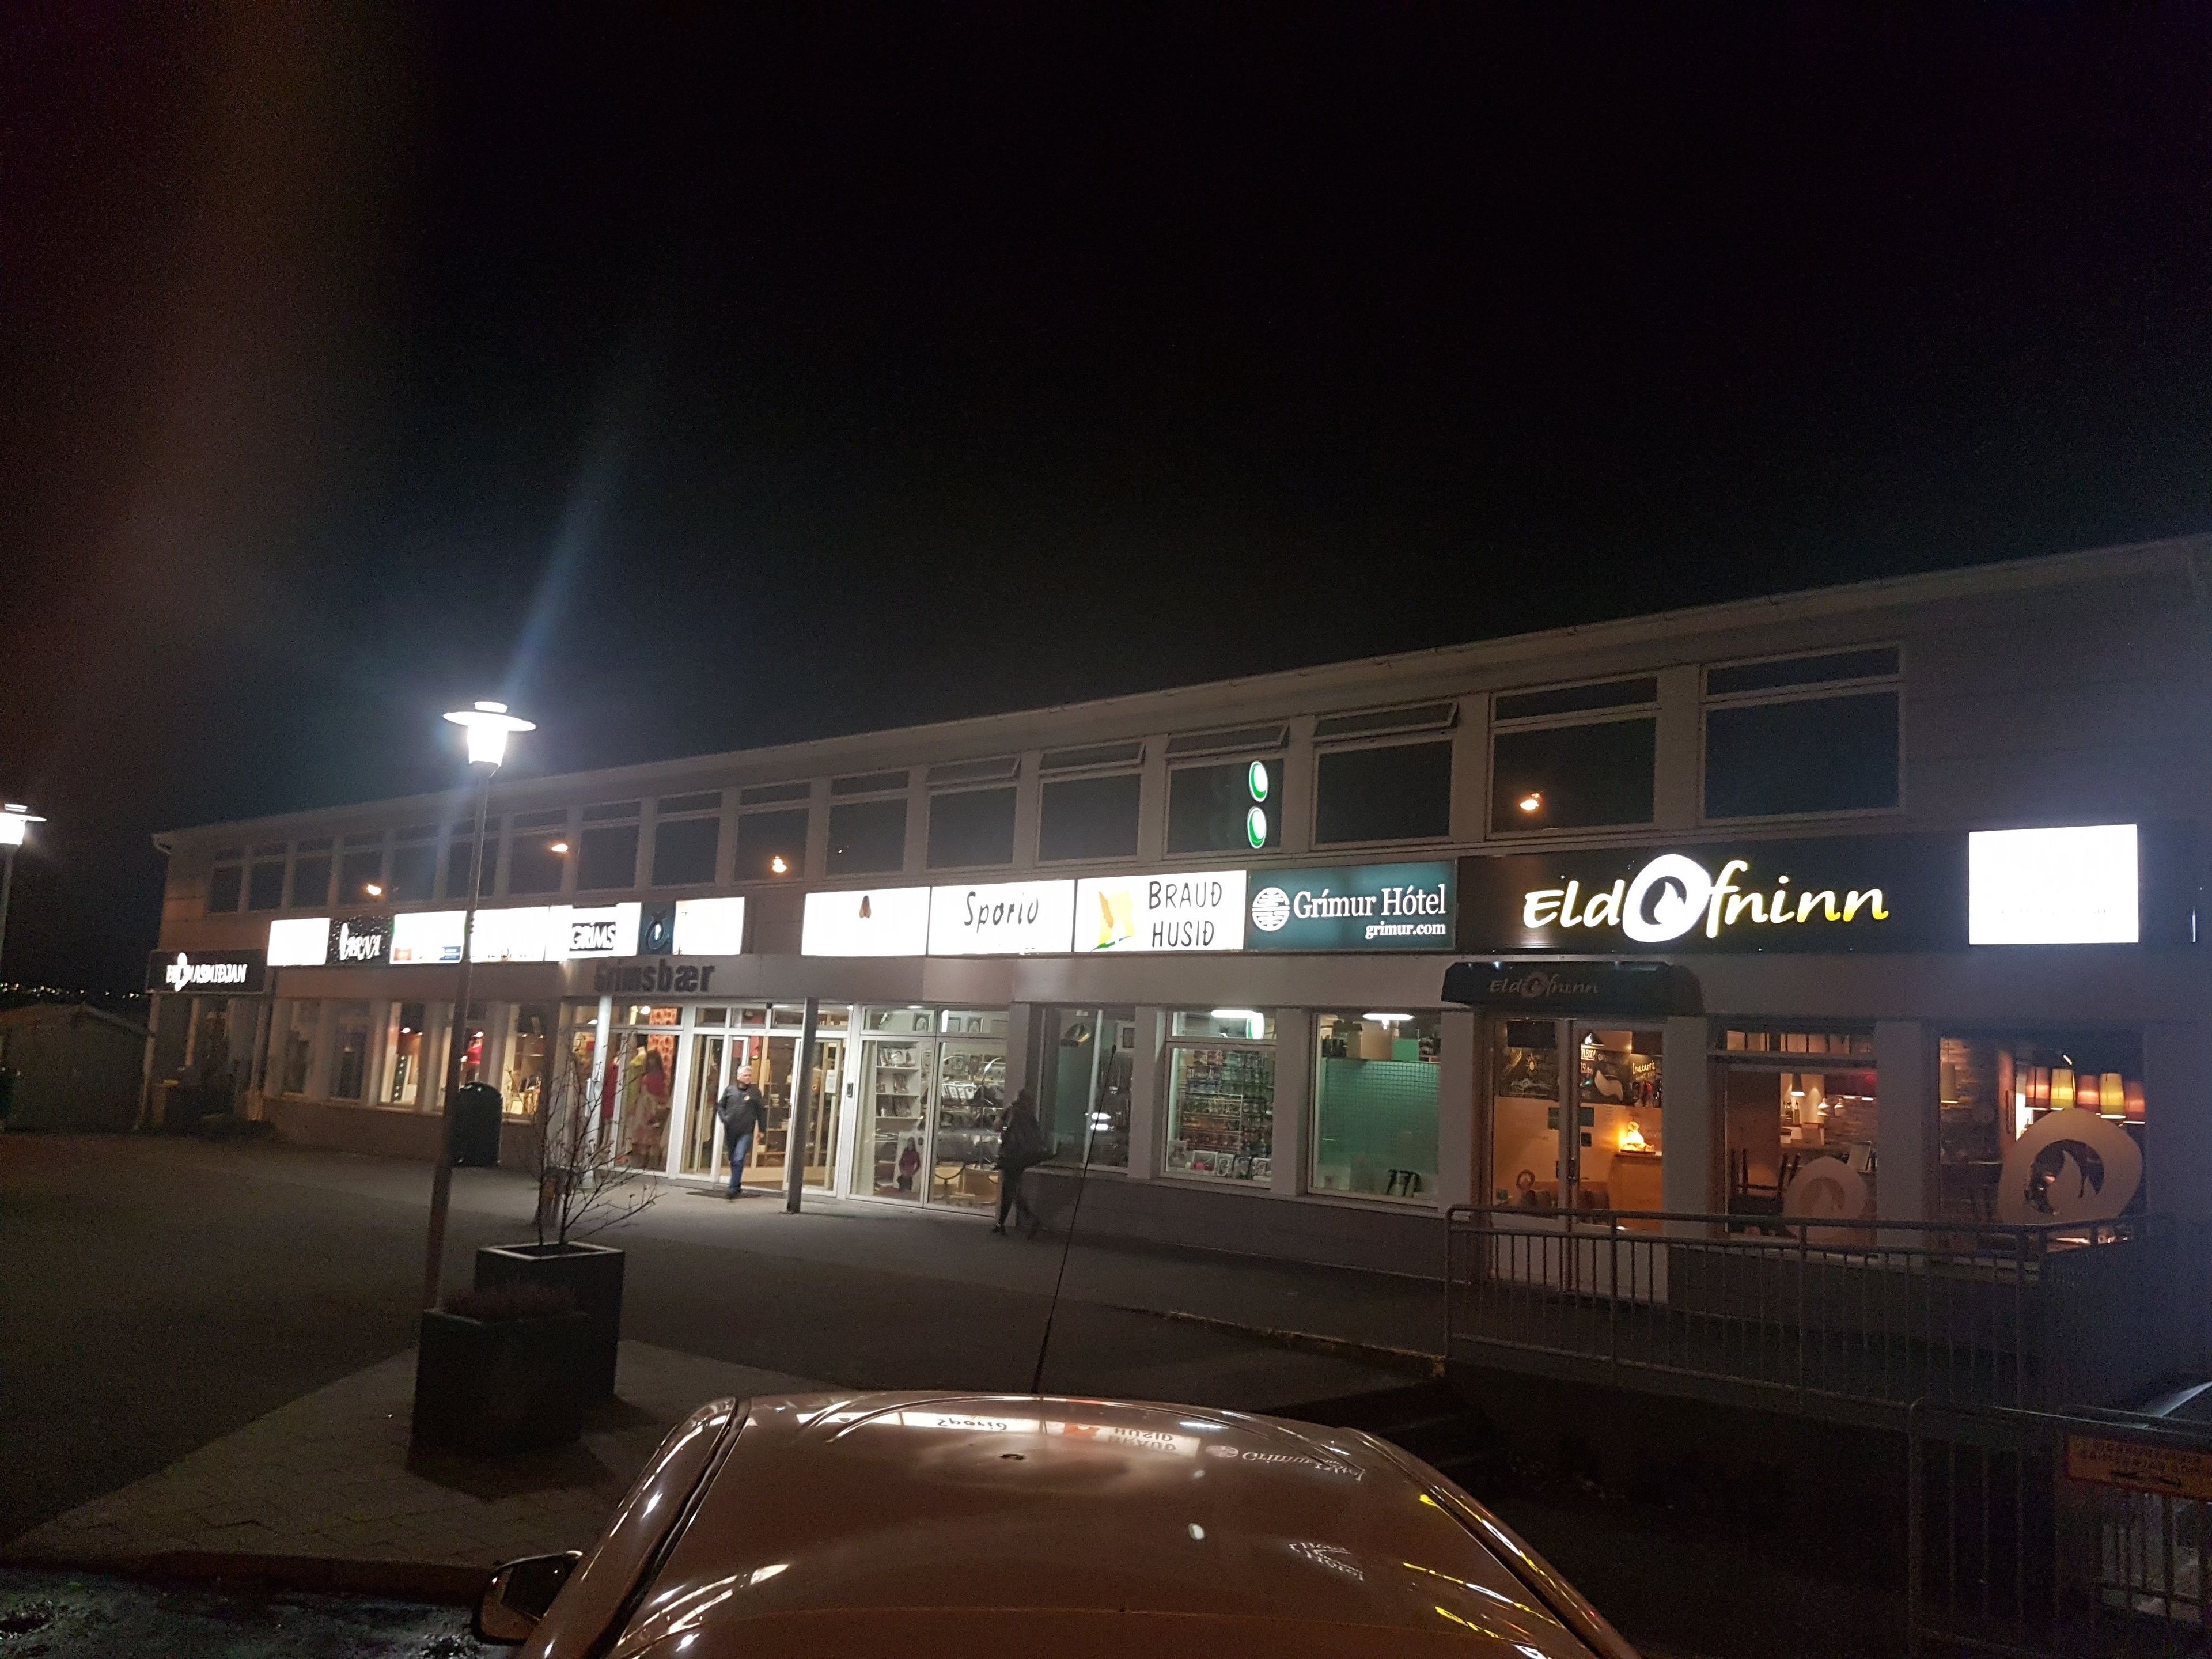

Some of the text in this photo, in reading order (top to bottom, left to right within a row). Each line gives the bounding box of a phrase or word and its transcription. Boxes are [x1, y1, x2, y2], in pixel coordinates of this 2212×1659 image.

[1293, 884, 1446, 919] Grímur Hótel
[1365, 922, 1446, 940] grimur.com
